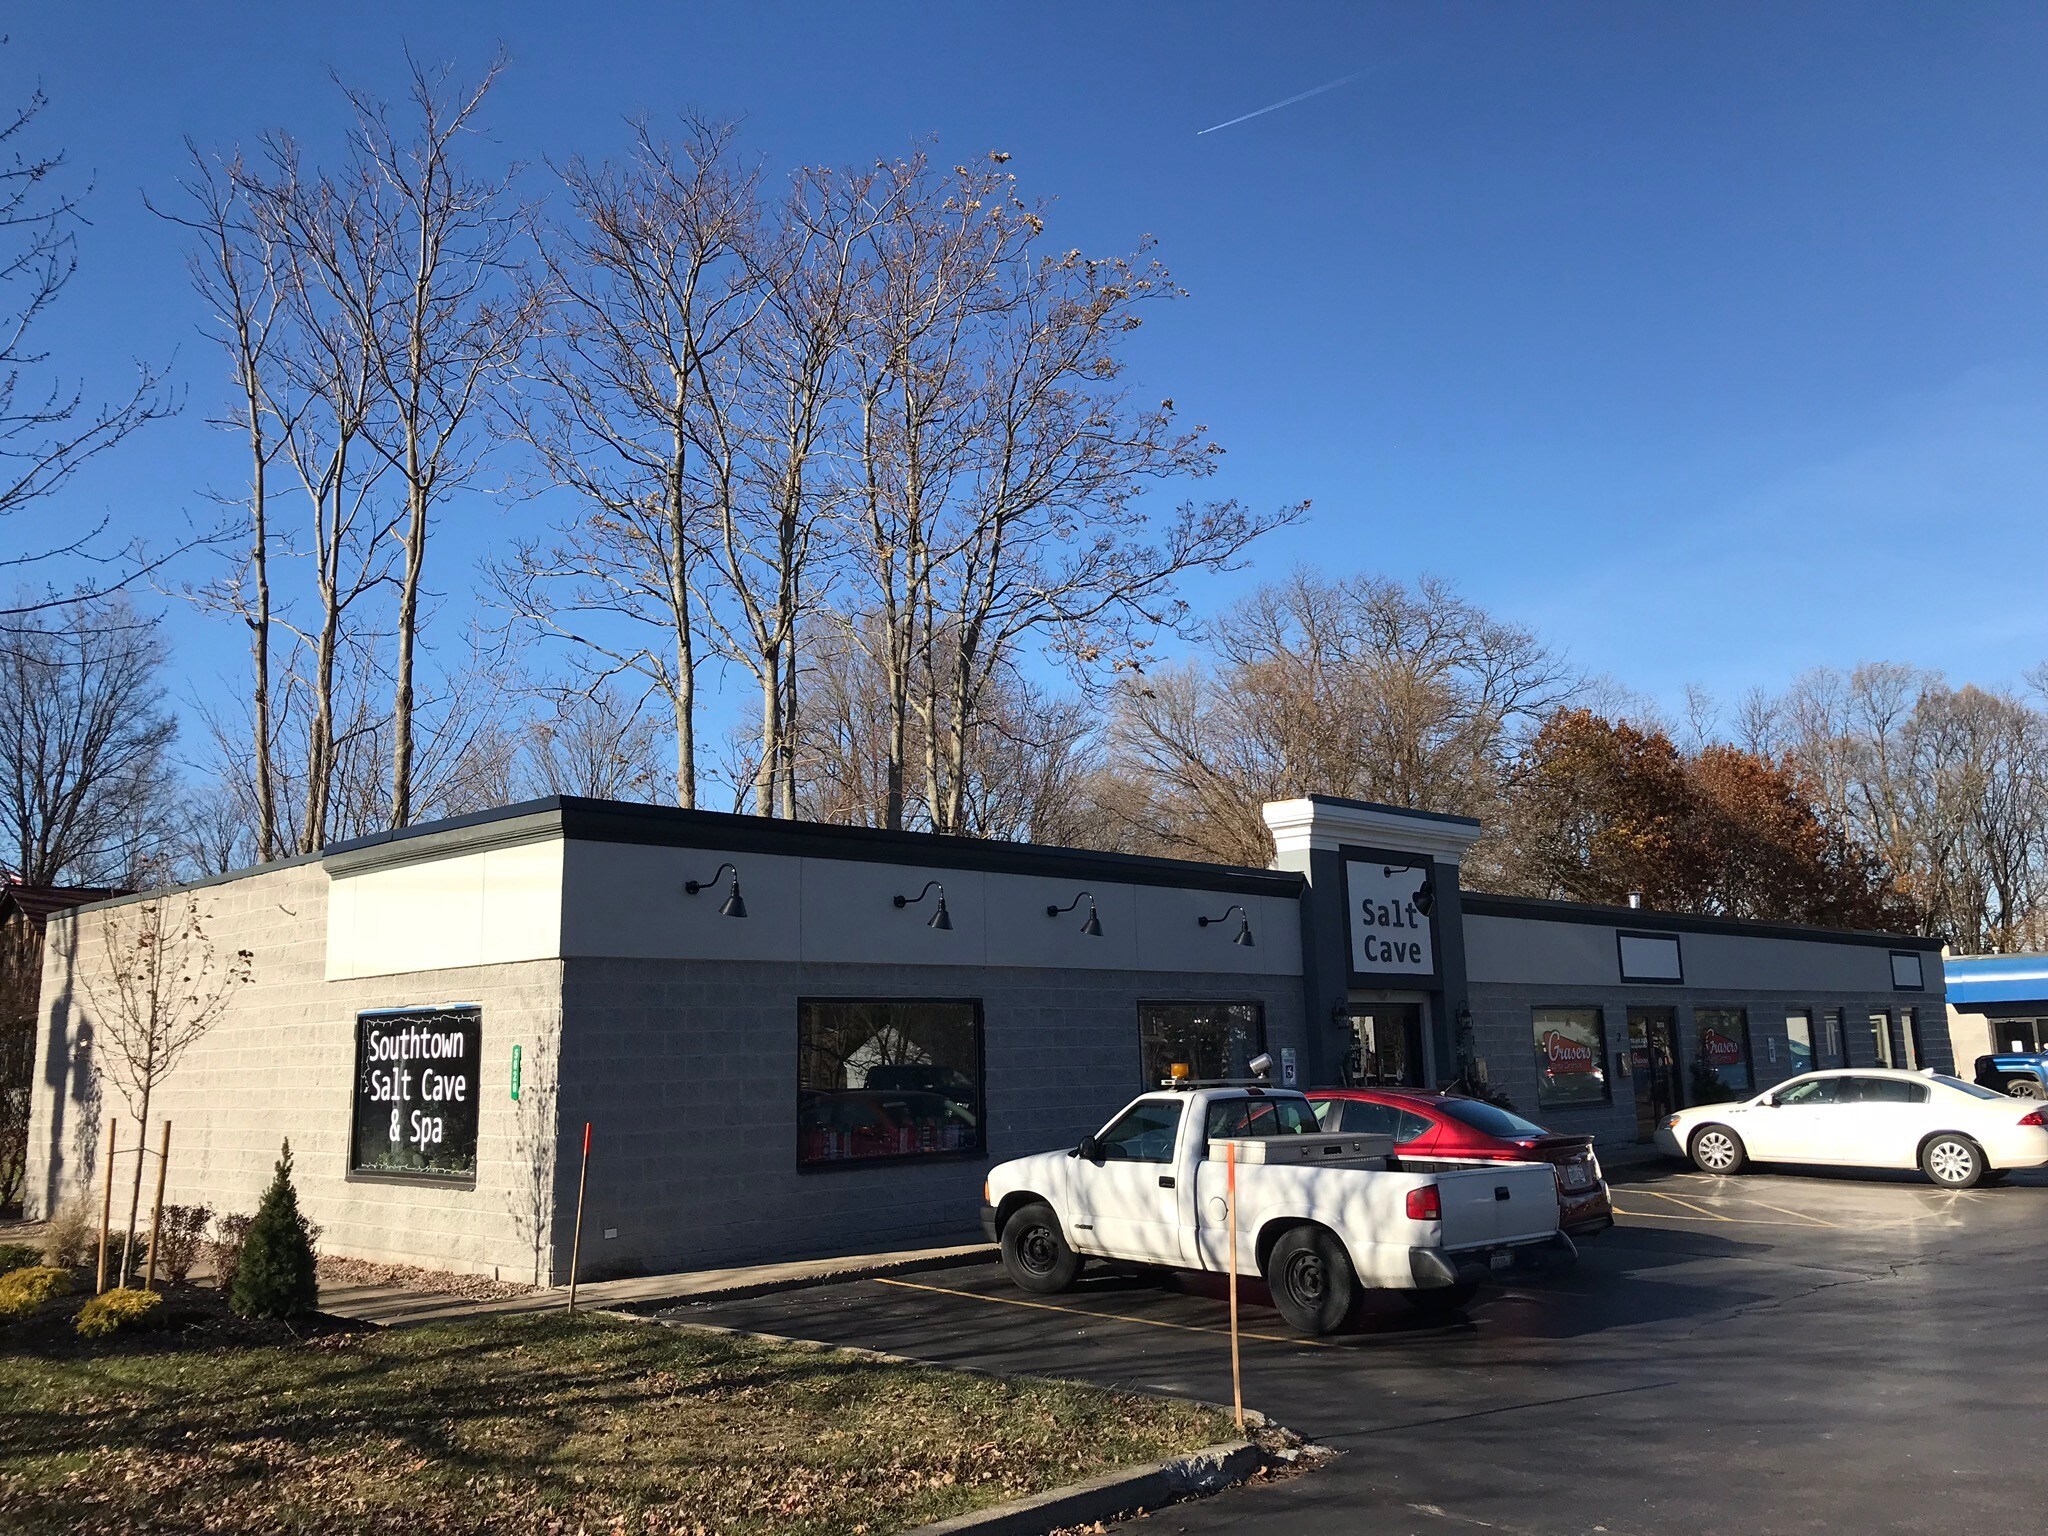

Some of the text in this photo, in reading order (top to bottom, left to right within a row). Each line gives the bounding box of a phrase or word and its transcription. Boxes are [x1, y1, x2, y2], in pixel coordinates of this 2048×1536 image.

[1362, 898, 1419, 929] Salt
[1364, 934, 1421, 964] Cave
[369, 1025, 464, 1062] Southtown
[370, 1067, 466, 1101] Salt Cave
[389, 1108, 443, 1151] & Spa
